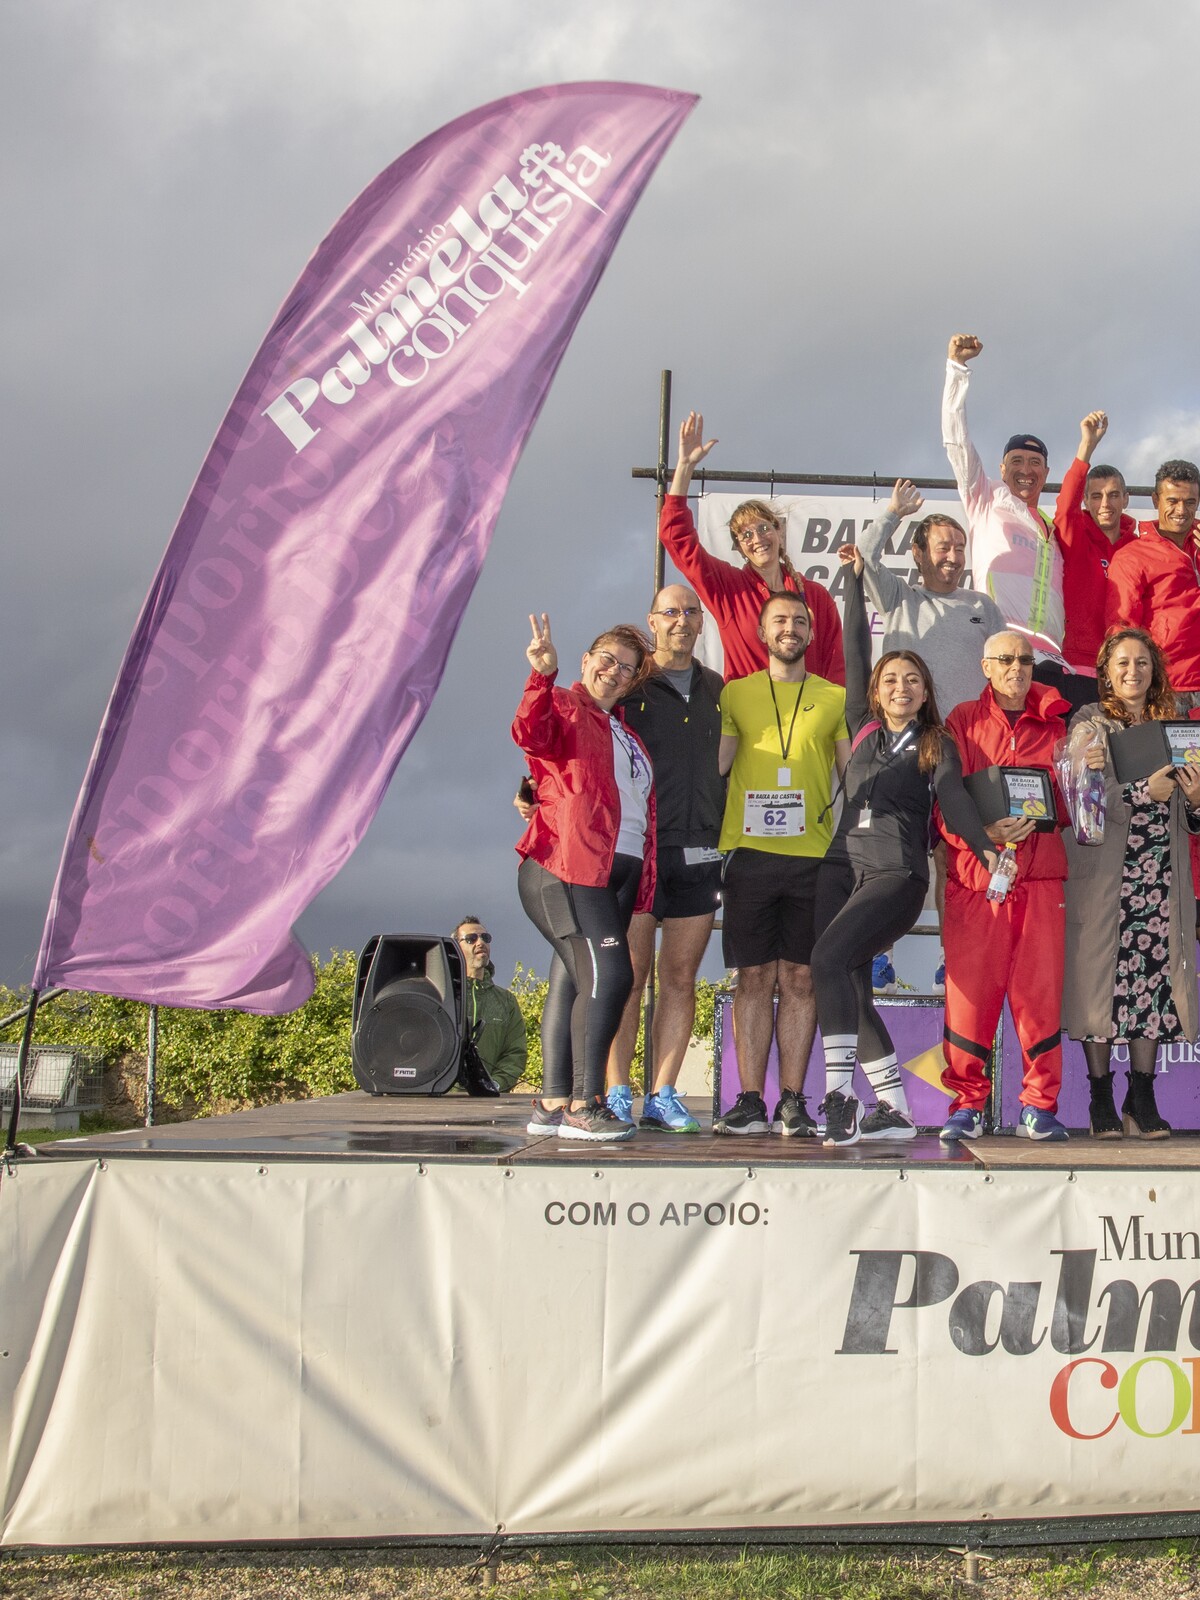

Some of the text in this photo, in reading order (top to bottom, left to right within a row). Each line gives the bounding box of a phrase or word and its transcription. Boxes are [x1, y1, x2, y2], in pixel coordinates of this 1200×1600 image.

[349, 223, 447, 319] Município
[387, 142, 612, 388] conquista
[261, 173, 528, 454] Palmela
[764, 810, 787, 826] 62
[544, 1201, 770, 1227] COM O APOIO:
